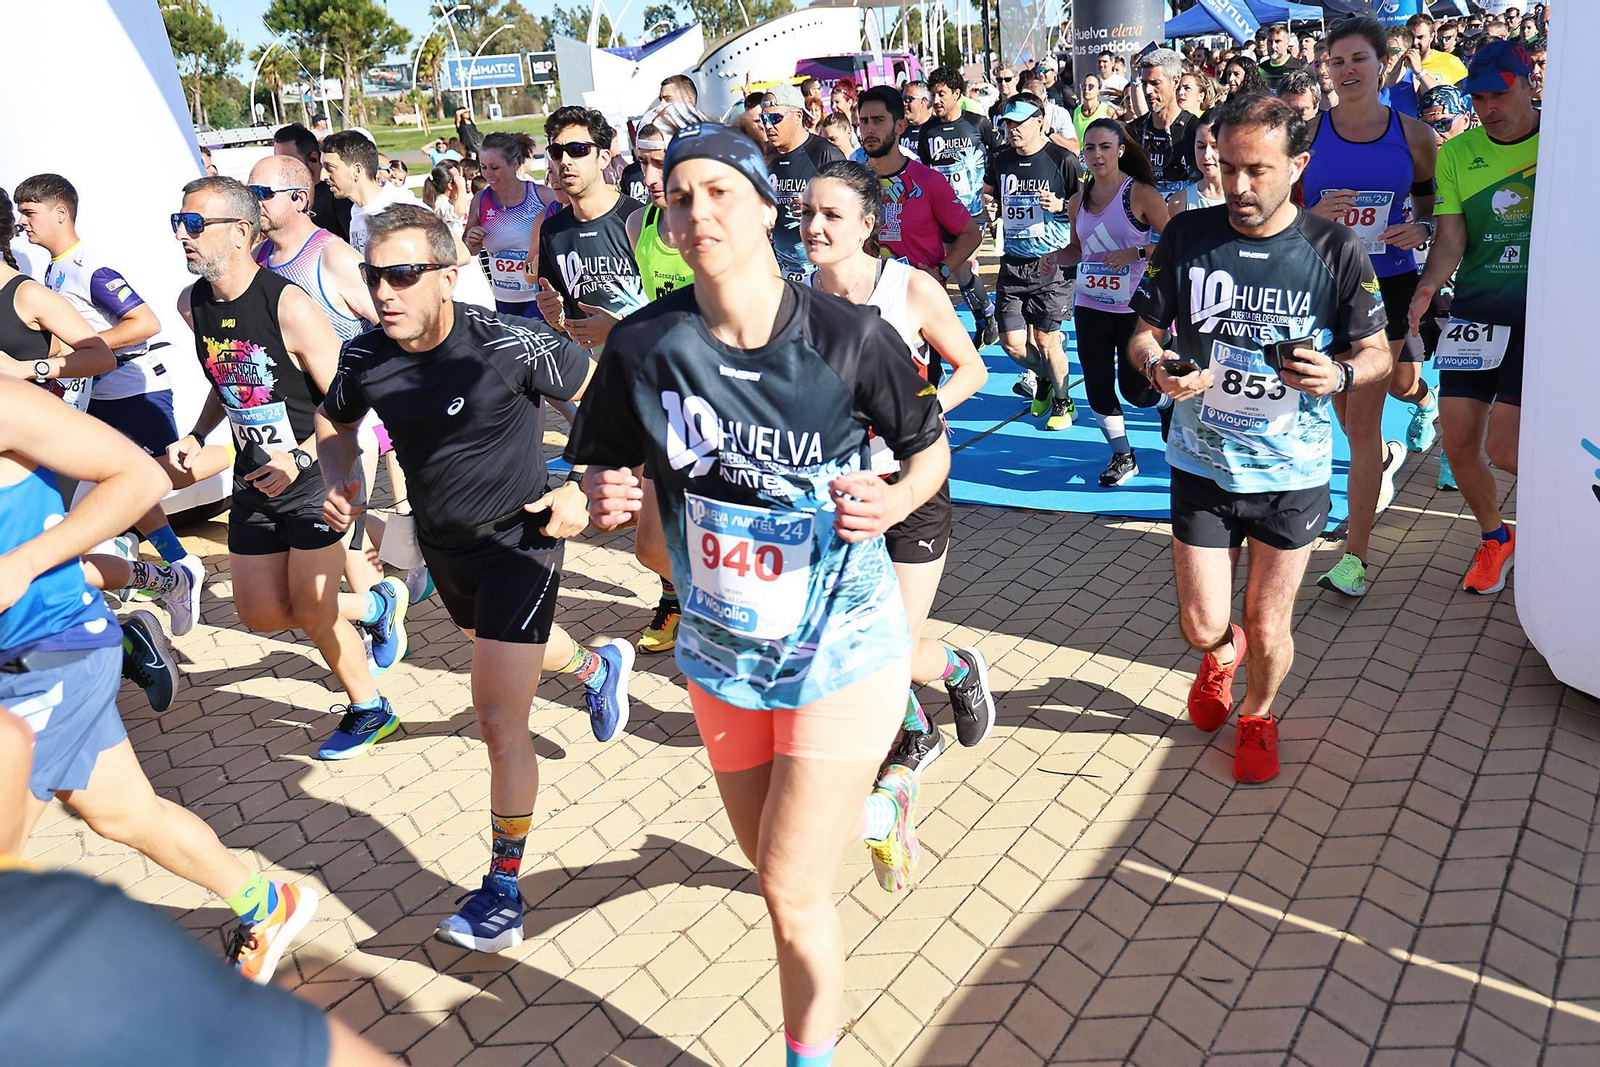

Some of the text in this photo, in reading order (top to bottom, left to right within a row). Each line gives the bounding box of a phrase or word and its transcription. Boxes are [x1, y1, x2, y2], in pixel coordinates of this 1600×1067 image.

[1074, 23, 1143, 40] Huelva eleva
[1075, 39, 1140, 55] tus sentidos
[928, 136, 973, 161] 10 HUELVA
[776, 179, 807, 192] HUELVA
[1000, 173, 1051, 195] 10 HUELVA
[1007, 206, 1034, 220] 951
[1333, 207, 1376, 226] 08
[1495, 212, 1531, 221] CAMPING
[496, 259, 525, 272] 624
[556, 250, 633, 298] 10 HUELVA
[654, 270, 674, 281] Running
[1085, 275, 1121, 290] 345
[1188, 267, 1311, 334] 10 HUELVA
[1230, 310, 1251, 319] PUERTA
[1252, 312, 1262, 322] DEL
[1446, 323, 1494, 342] 461
[1217, 344, 1231, 364] 10
[1444, 357, 1479, 366] Wayalia
[215, 362, 259, 377] VALENCIA
[215, 374, 263, 385] THROWDOWN
[1222, 369, 1287, 401] 853
[1216, 411, 1263, 428] Wayalia
[661, 390, 824, 479] 10 HUELVA
[702, 532, 783, 582] 940
[704, 593, 750, 623] Wayalia
